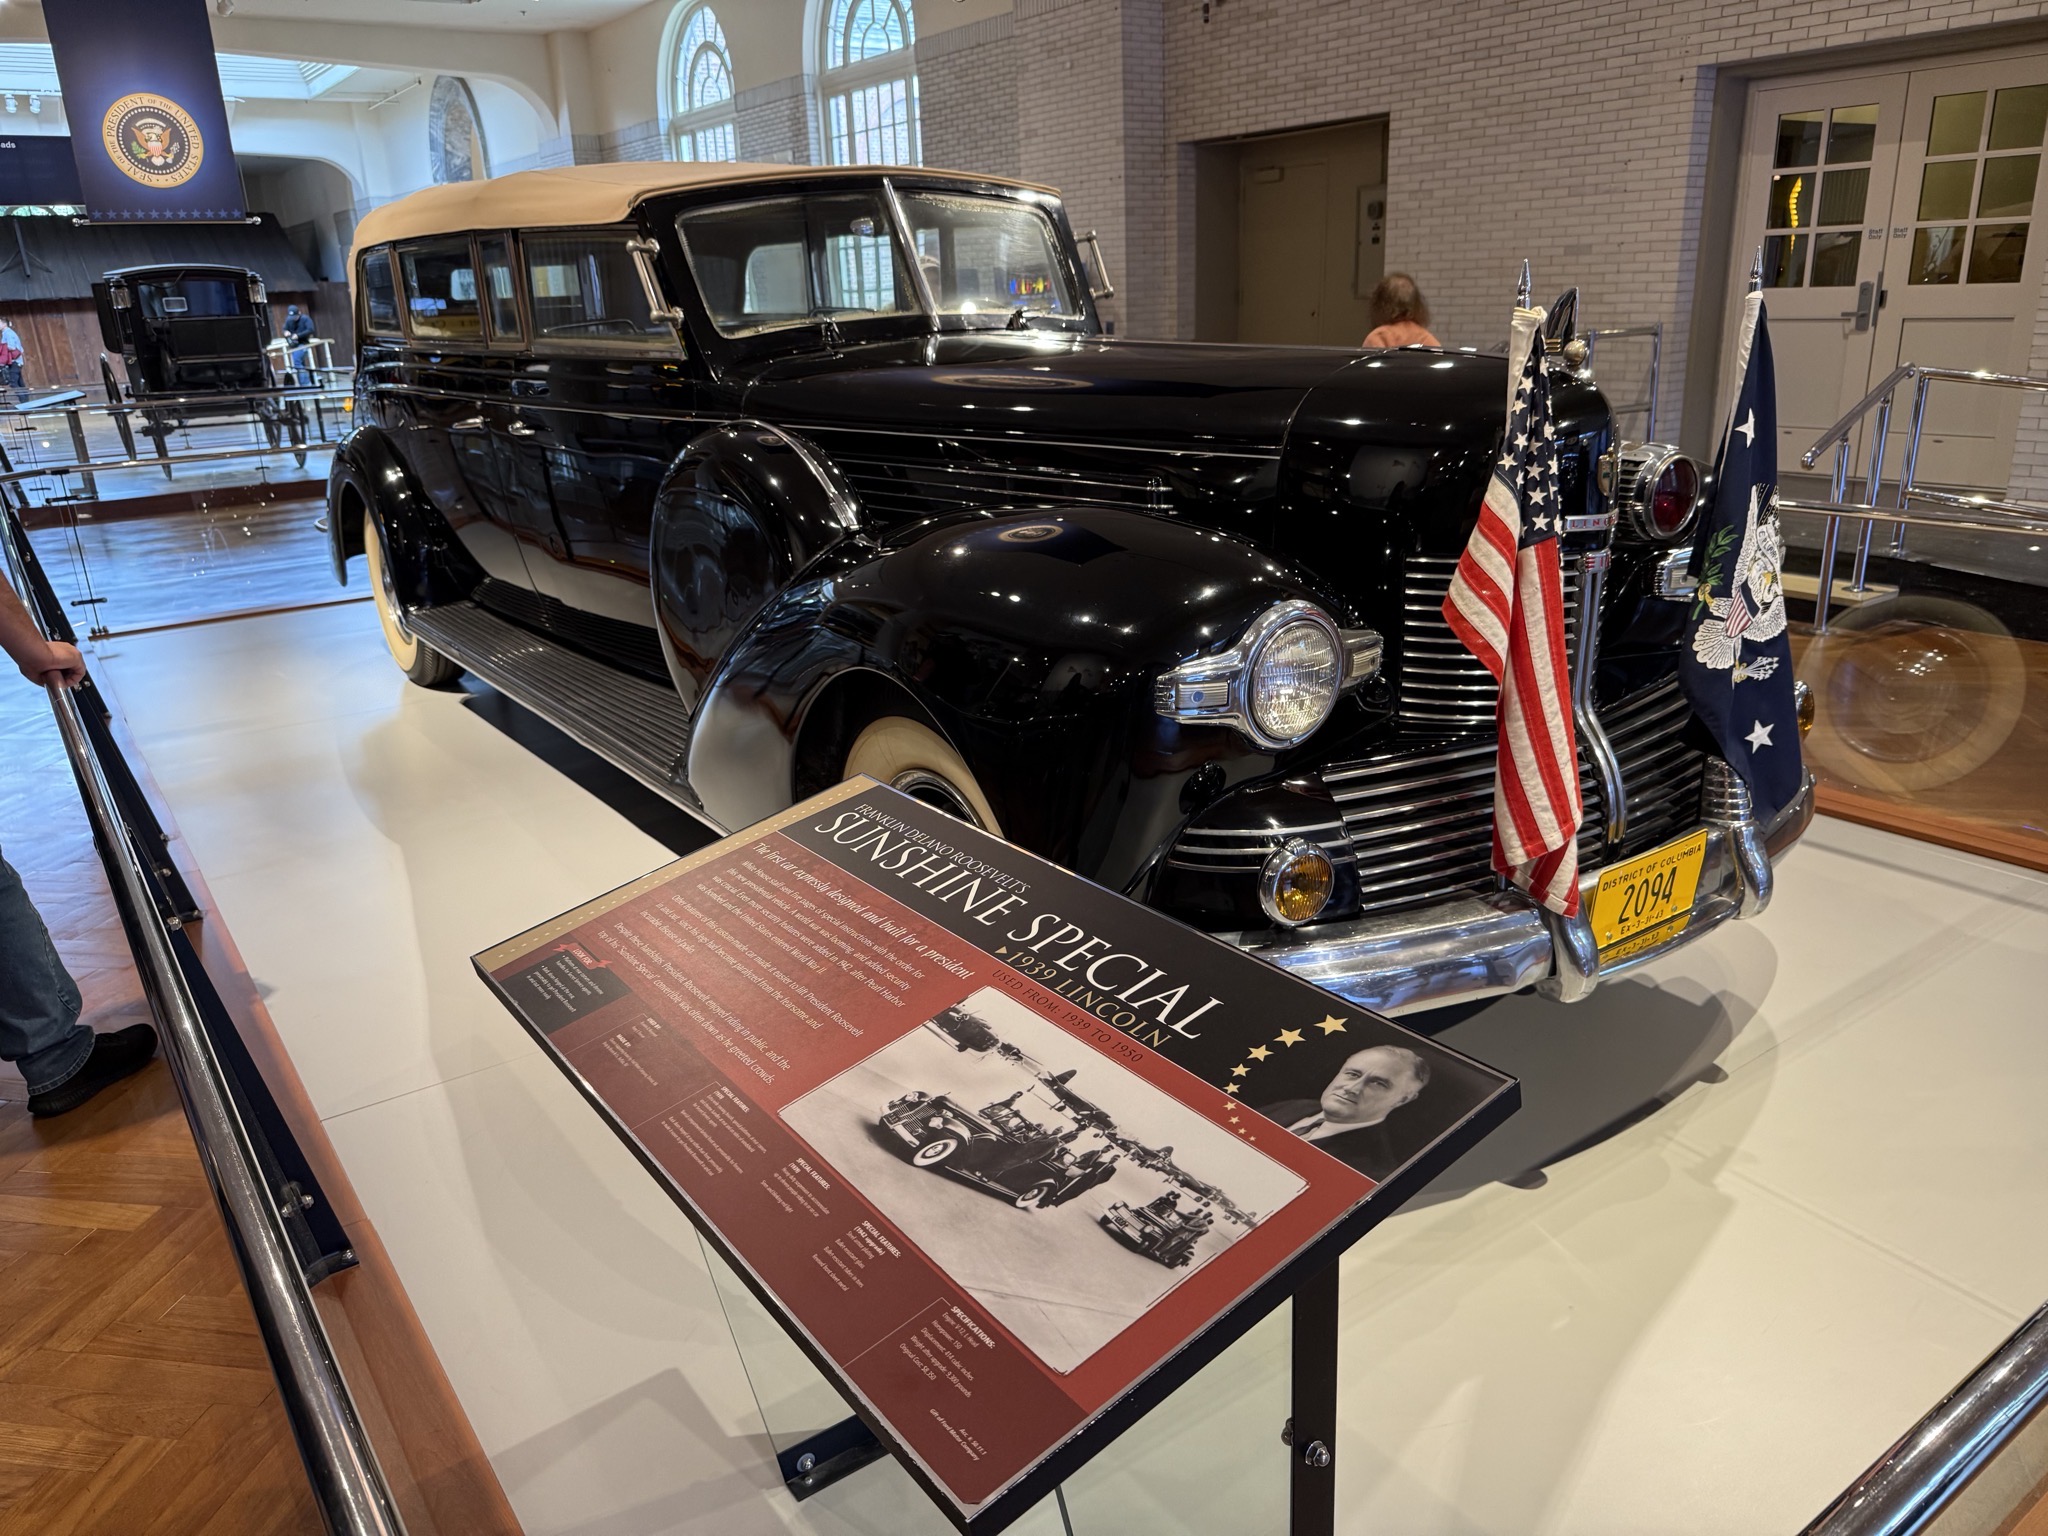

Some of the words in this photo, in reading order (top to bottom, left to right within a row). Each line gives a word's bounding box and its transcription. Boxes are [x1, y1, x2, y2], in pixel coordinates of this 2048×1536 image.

[106, 96, 145, 138] PRESIDENT
[159, 100, 173, 111] THE
[174, 109, 200, 150] UNITED
[126, 165, 153, 183] SEAL
[170, 153, 199, 183] STATES
[1571, 515, 1616, 529] LINC
[853, 803, 910, 832] FRANKLIN
[903, 828, 954, 855] DELANO
[1602, 867, 1644, 892] DISTRICT
[1646, 861, 1658, 874] OF
[1660, 843, 1702, 869] COLUMBIA
[741, 860, 757, 871] White
[753, 868, 771, 881] House
[767, 878, 785, 888] staff
[778, 885, 794, 894] sent
[789, 891, 802, 900] five
[797, 898, 817, 910] pages
[819, 911, 844, 926] special
[838, 922, 874, 947] instructions
[871, 944, 888, 955] with
[883, 952, 897, 961] the
[894, 959, 915, 972] order
[911, 969, 925, 978] for
[752, 842, 770, 854] The
[762, 850, 787, 864] first
[779, 861, 798, 870] car
[792, 869, 831, 892] expressly
[825, 888, 870, 913] designed
[860, 911, 888, 924] and
[878, 920, 907, 937] built
[897, 933, 920, 945] for
[920, 949, 975, 979] president
[1617, 865, 1679, 925] 2094
[735, 891, 751, 902] Even
[747, 900, 763, 910] more
[759, 908, 782, 923] security
[778, 920, 802, 937] features
[799, 935, 815, 946] were
[811, 943, 835, 958] added
[828, 954, 838, 962] in
[849, 969, 867, 981] after
[863, 978, 885, 992] Pearl
[879, 988, 906, 1007] Harbor
[742, 879, 776, 899] presidential
[793, 912, 814, 924] world
[808, 922, 821, 930] war
[818, 928, 832, 938] was
[852, 951, 871, 962] and
[864, 959, 890, 974] added
[883, 971, 911, 991] security
[814, 811, 1028, 925] SUNSHINE
[1006, 913, 1224, 1039] SPECIAL
[991, 969, 1023, 989] USED
[1021, 987, 1060, 1013] FROM:
[1060, 1011, 1091, 1029] 1939
[1090, 1027, 1111, 1042] TO
[1110, 1041, 1143, 1062] 1950
[1005, 951, 1057, 979] 1939
[1053, 978, 1171, 1047] LINCOLN
[861, 1220, 880, 1238] SPECIAL
[950, 1305, 995, 1348] SPECIFICATIONS:
